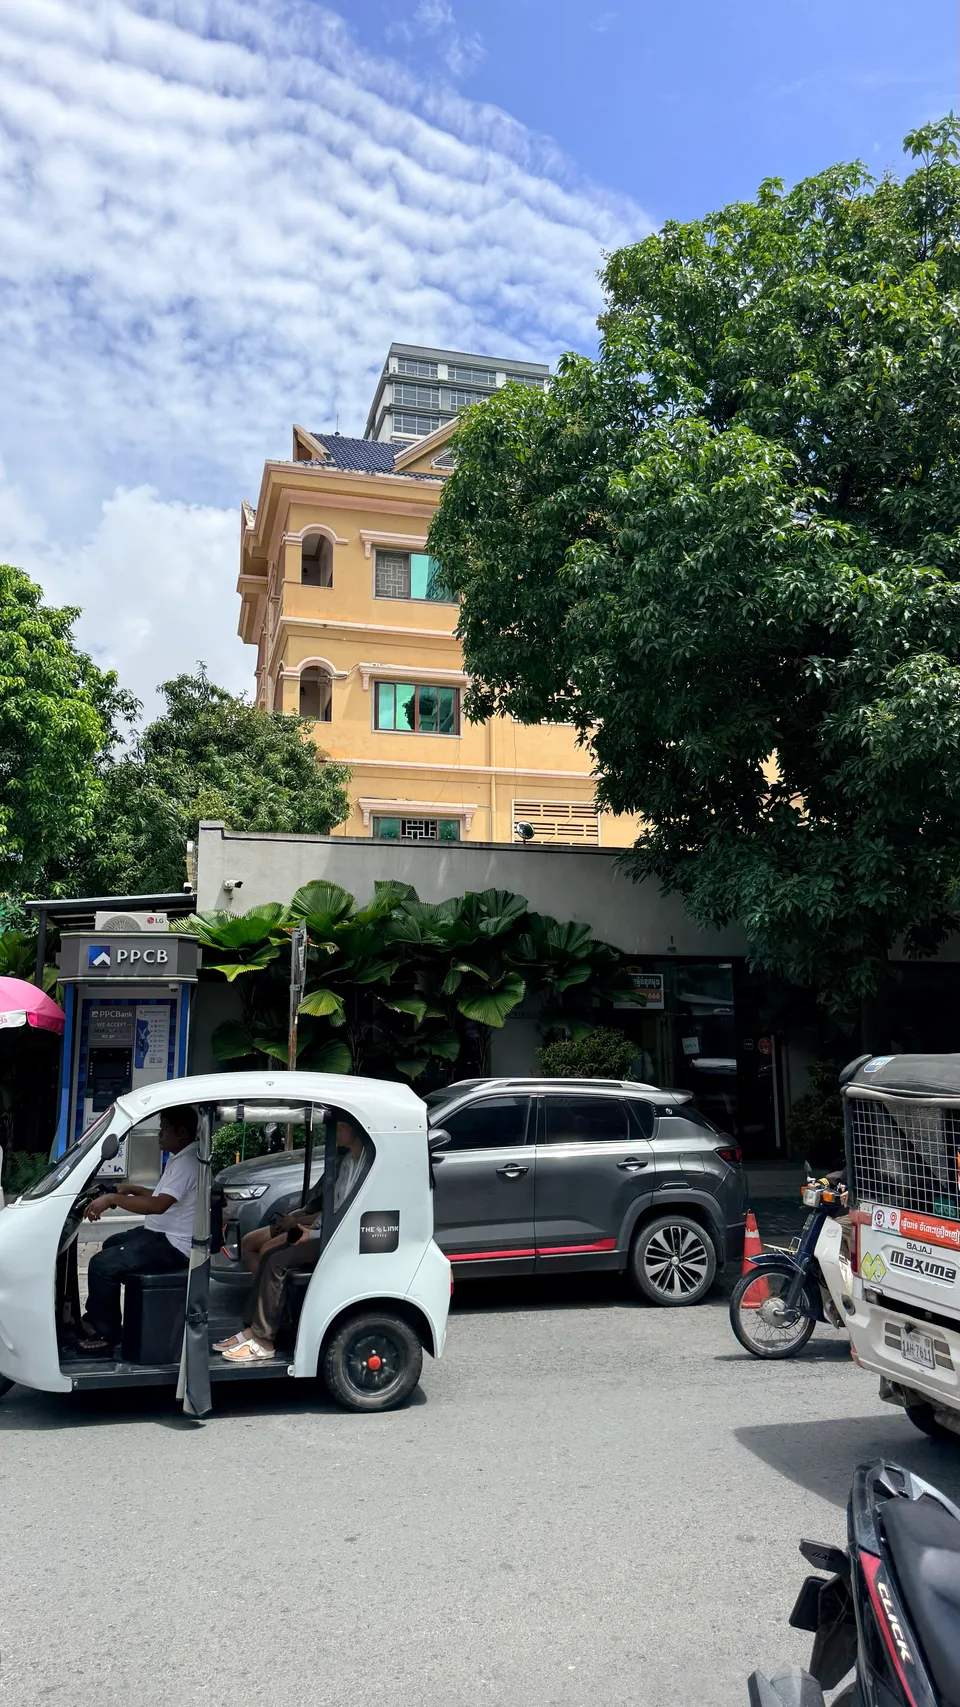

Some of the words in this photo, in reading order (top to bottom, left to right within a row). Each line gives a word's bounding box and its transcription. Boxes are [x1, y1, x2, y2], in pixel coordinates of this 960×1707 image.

[116, 949, 169, 963] PPCB
[100, 1010, 133, 1018] PPCBank
[906, 1242, 933, 1255] BAJAJ
[877, 1581, 915, 1667] CLICK
